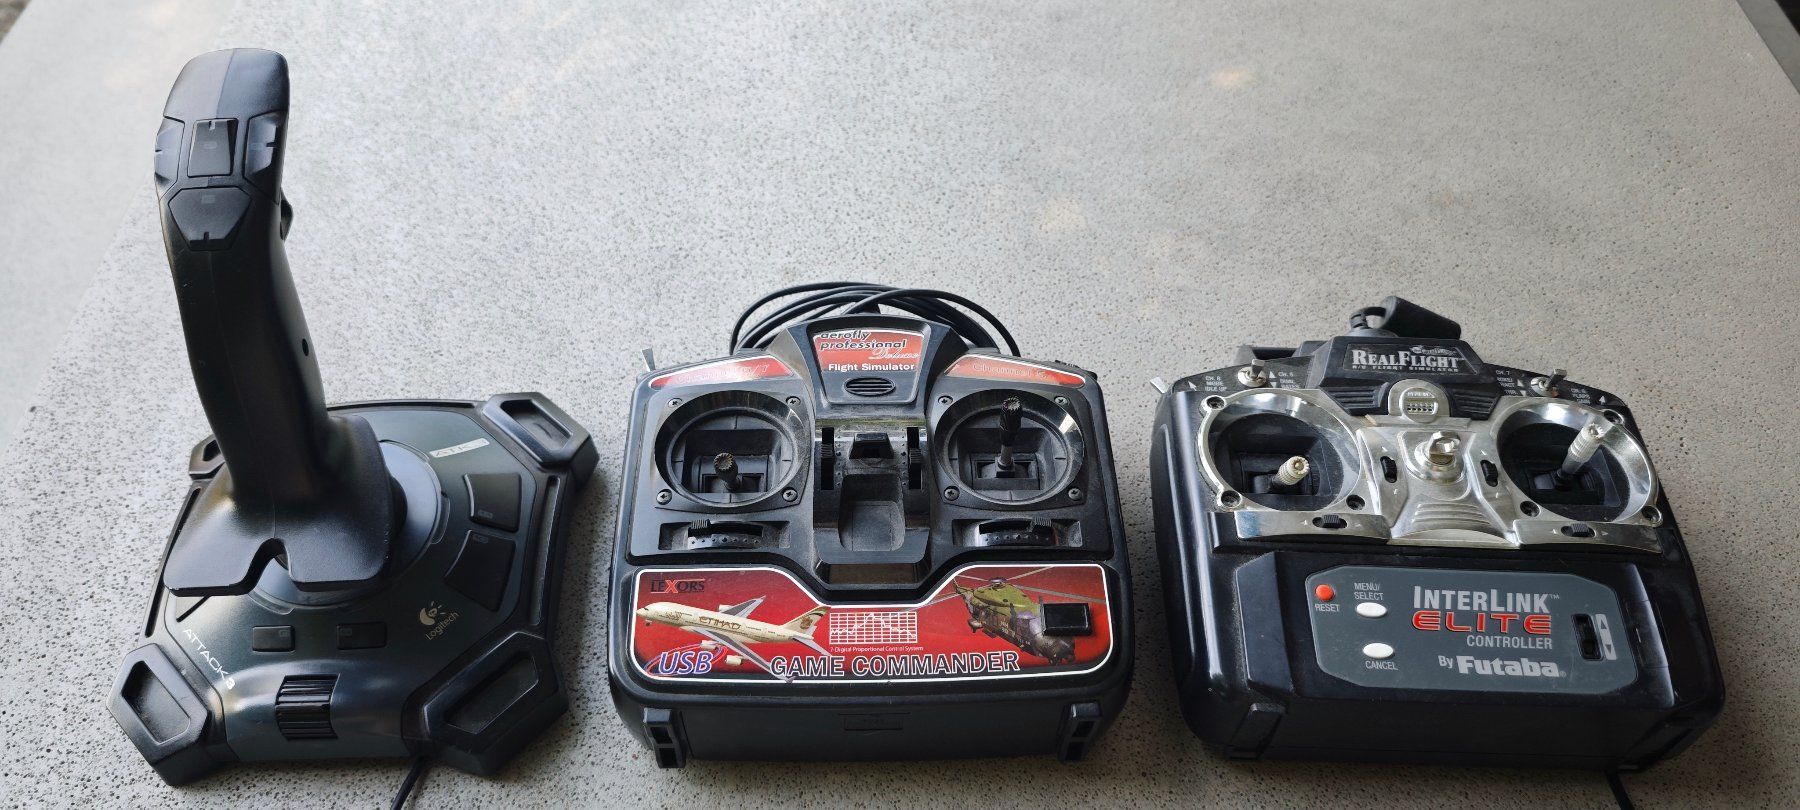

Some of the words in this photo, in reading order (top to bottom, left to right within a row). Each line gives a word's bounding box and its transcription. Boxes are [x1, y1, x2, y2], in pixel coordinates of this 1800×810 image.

[820, 340, 906, 350] professional
[828, 363, 858, 372] Flight
[861, 363, 915, 371] Simulator
[650, 580, 705, 594] LEXORS
[1353, 592, 1384, 601] SELECT
[1314, 603, 1340, 612] RESET
[425, 612, 459, 640] Logitech
[1412, 610, 1552, 635] ELITE
[1466, 634, 1553, 650] CONTROLLER
[658, 651, 714, 675] USB
[769, 656, 845, 677] GAME
[851, 651, 1021, 677] COMMANDER
[1365, 660, 1398, 670] CANCEL
[1438, 655, 1453, 668] By
